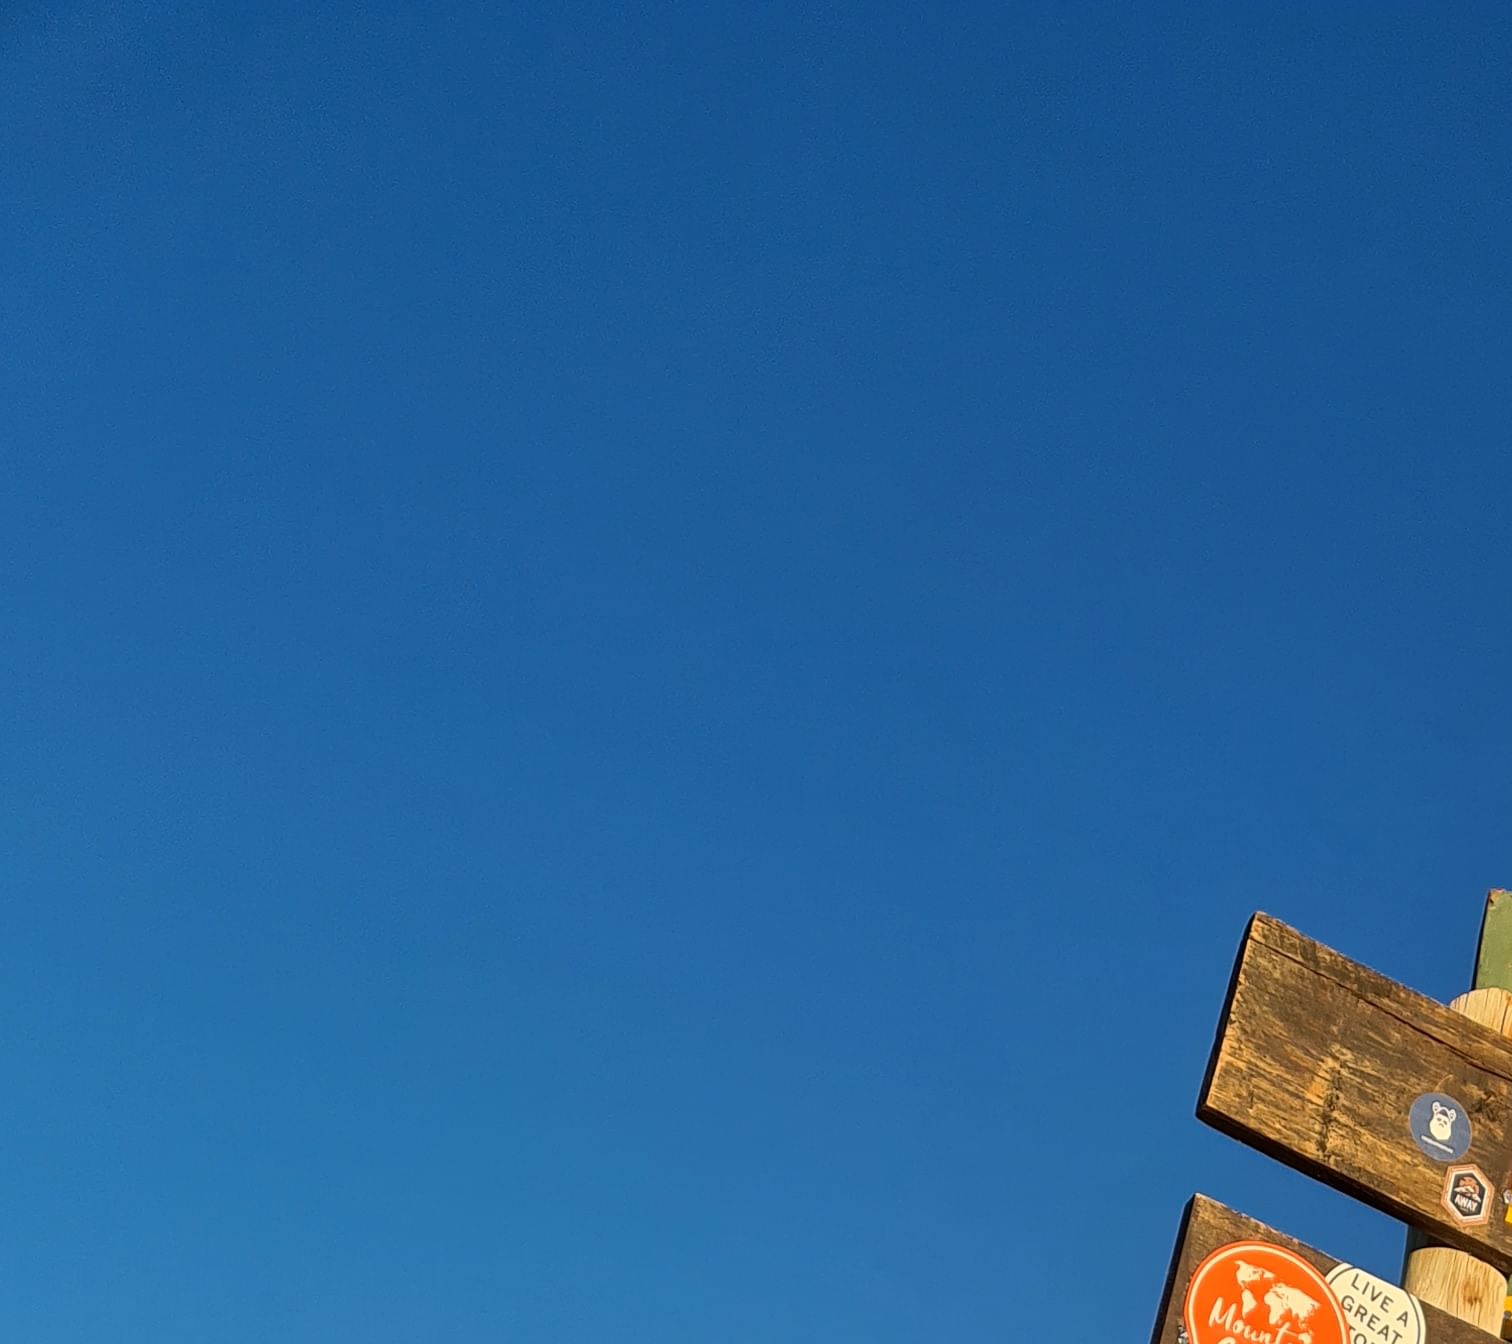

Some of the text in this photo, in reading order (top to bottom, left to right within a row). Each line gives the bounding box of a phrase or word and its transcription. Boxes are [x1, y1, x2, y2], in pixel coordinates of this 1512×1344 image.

[1454, 1194, 1479, 1212] AWAY
[1350, 1272, 1409, 1328] LIVE A
